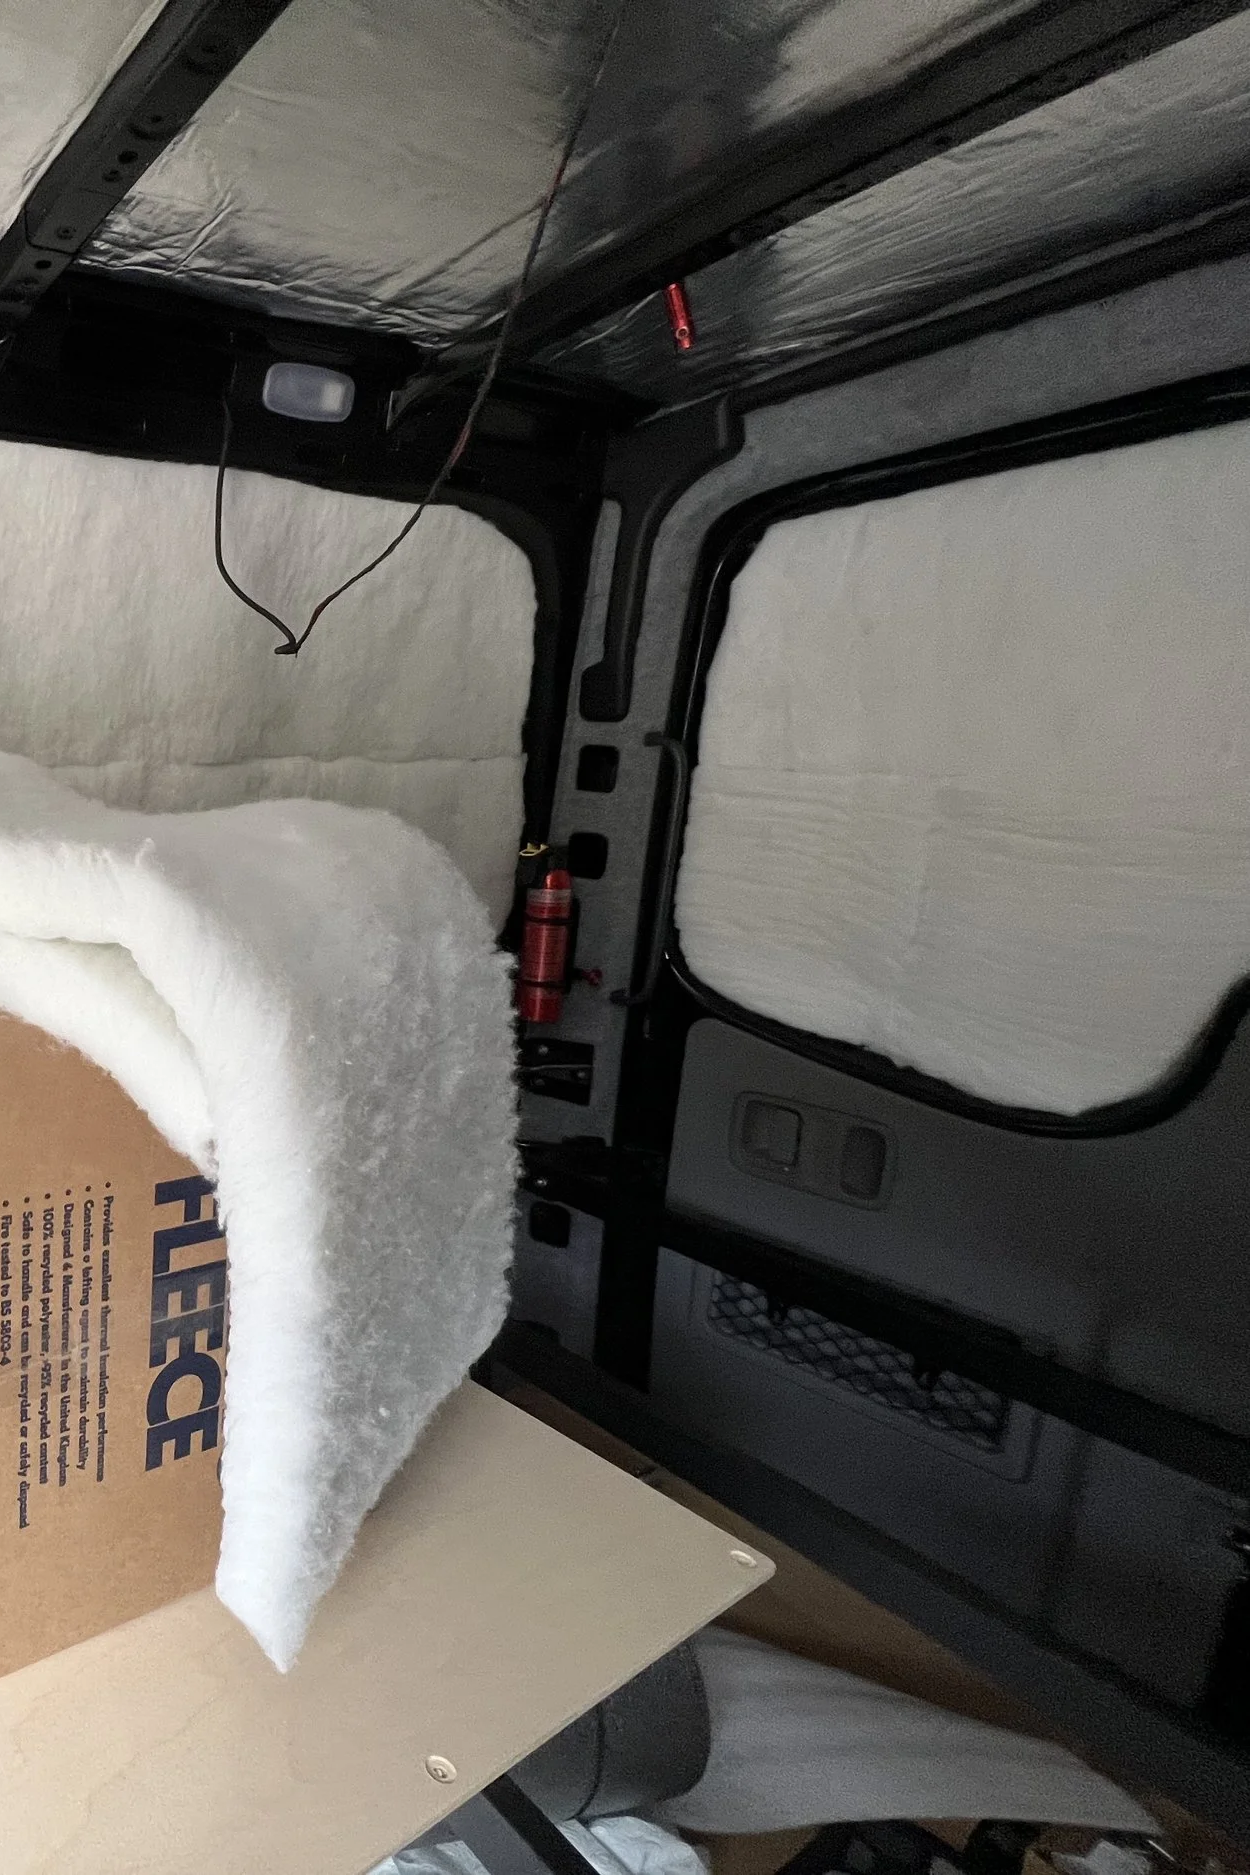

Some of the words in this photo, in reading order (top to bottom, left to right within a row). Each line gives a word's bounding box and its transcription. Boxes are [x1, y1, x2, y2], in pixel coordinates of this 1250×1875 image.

[1, 1214, 12, 1239] Fire
[22, 1211, 34, 1240] Safe
[42, 1207, 54, 1241] 100%
[61, 1203, 74, 1259] Designed
[83, 1199, 94, 1252] Contains
[102, 1195, 114, 1247] Provides
[0, 1242, 12, 1281] tested
[21, 1244, 32, 1257] to
[40, 1244, 54, 1294] recycled
[0, 1284, 11, 1297] to
[21, 1259, 33, 1302] handle
[80, 1266, 93, 1306] lofting
[101, 1249, 112, 1302] excellent
[0, 1300, 12, 1316] BS
[21, 1305, 32, 1329] and
[40, 1297, 52, 1356] polyester,
[61, 1274, 73, 1356] Manufactured
[100, 1305, 111, 1352] thermal
[145, 1174, 227, 1471] FLEECE
[0, 1320, 12, 1366] 5803-4
[20, 1355, 32, 1371] be
[21, 1331, 29, 1353] can
[81, 1346, 90, 1360] to
[18, 1374, 31, 1423] recycled
[60, 1373, 71, 1393] the
[80, 1362, 91, 1413] maintain
[98, 1354, 110, 1409] insulation
[19, 1425, 28, 1438] or
[38, 1392, 51, 1440] recycled
[60, 1395, 71, 1434] United
[17, 1441, 31, 1476] safely
[39, 1442, 49, 1484] content
[57, 1435, 70, 1487] Kingdom
[76, 1416, 90, 1470] durability
[96, 1411, 108, 1482] performance
[17, 1480, 31, 1529] disposed
